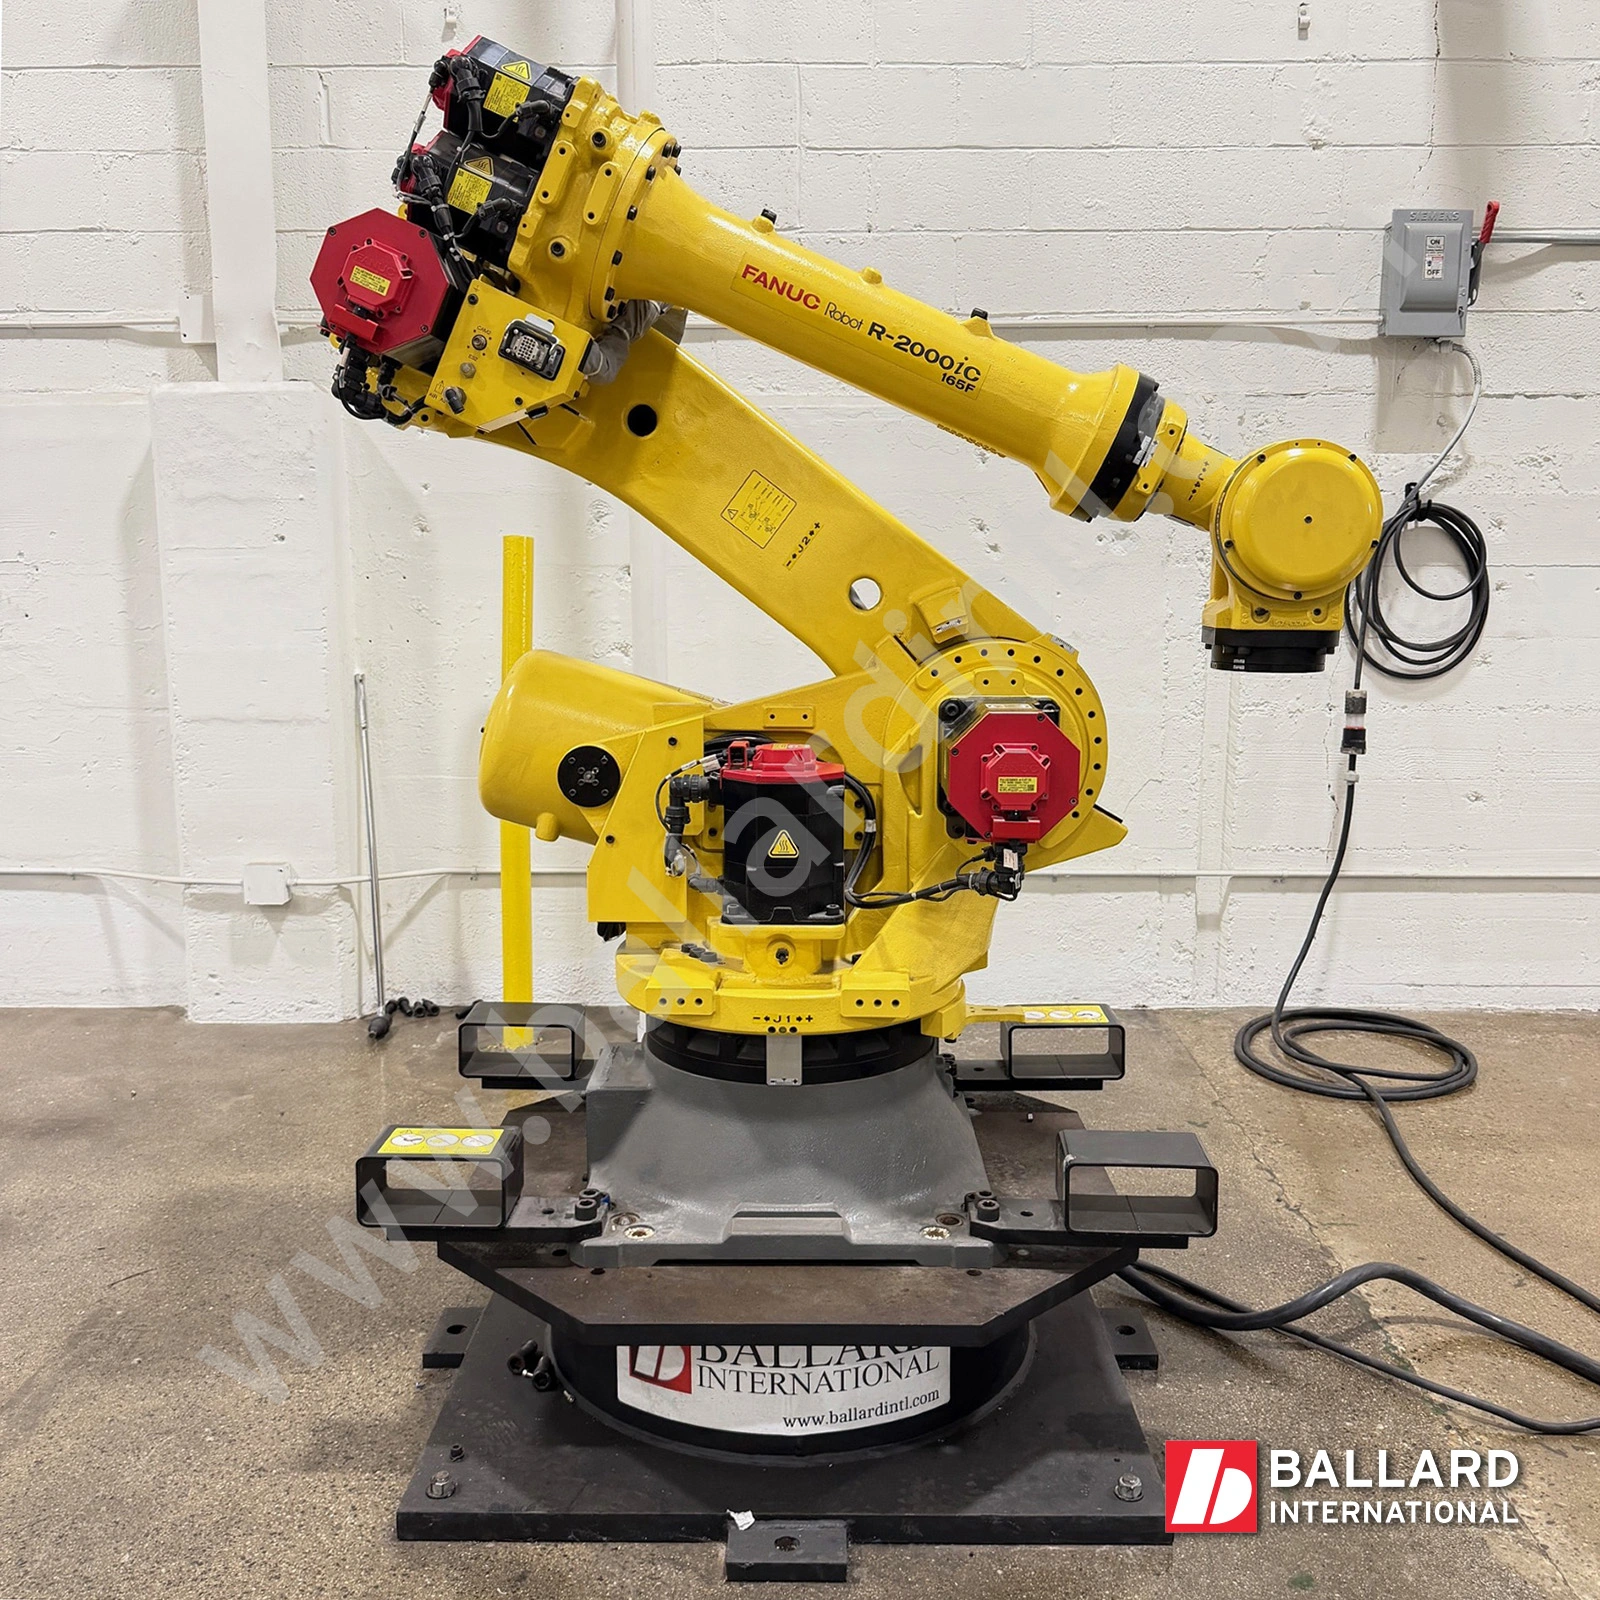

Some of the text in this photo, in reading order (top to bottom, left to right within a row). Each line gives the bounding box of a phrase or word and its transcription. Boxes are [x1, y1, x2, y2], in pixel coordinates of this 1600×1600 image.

[1409, 211, 1460, 222] SIEMENS
[741, 263, 821, 311] FANUC
[823, 301, 864, 331] Robot
[941, 372, 975, 393] 165F
[696, 1345, 923, 1369] BALLA
[697, 1350, 940, 1395] INTERNATIONAL
[782, 1387, 940, 1428] www.ballardintl.com
